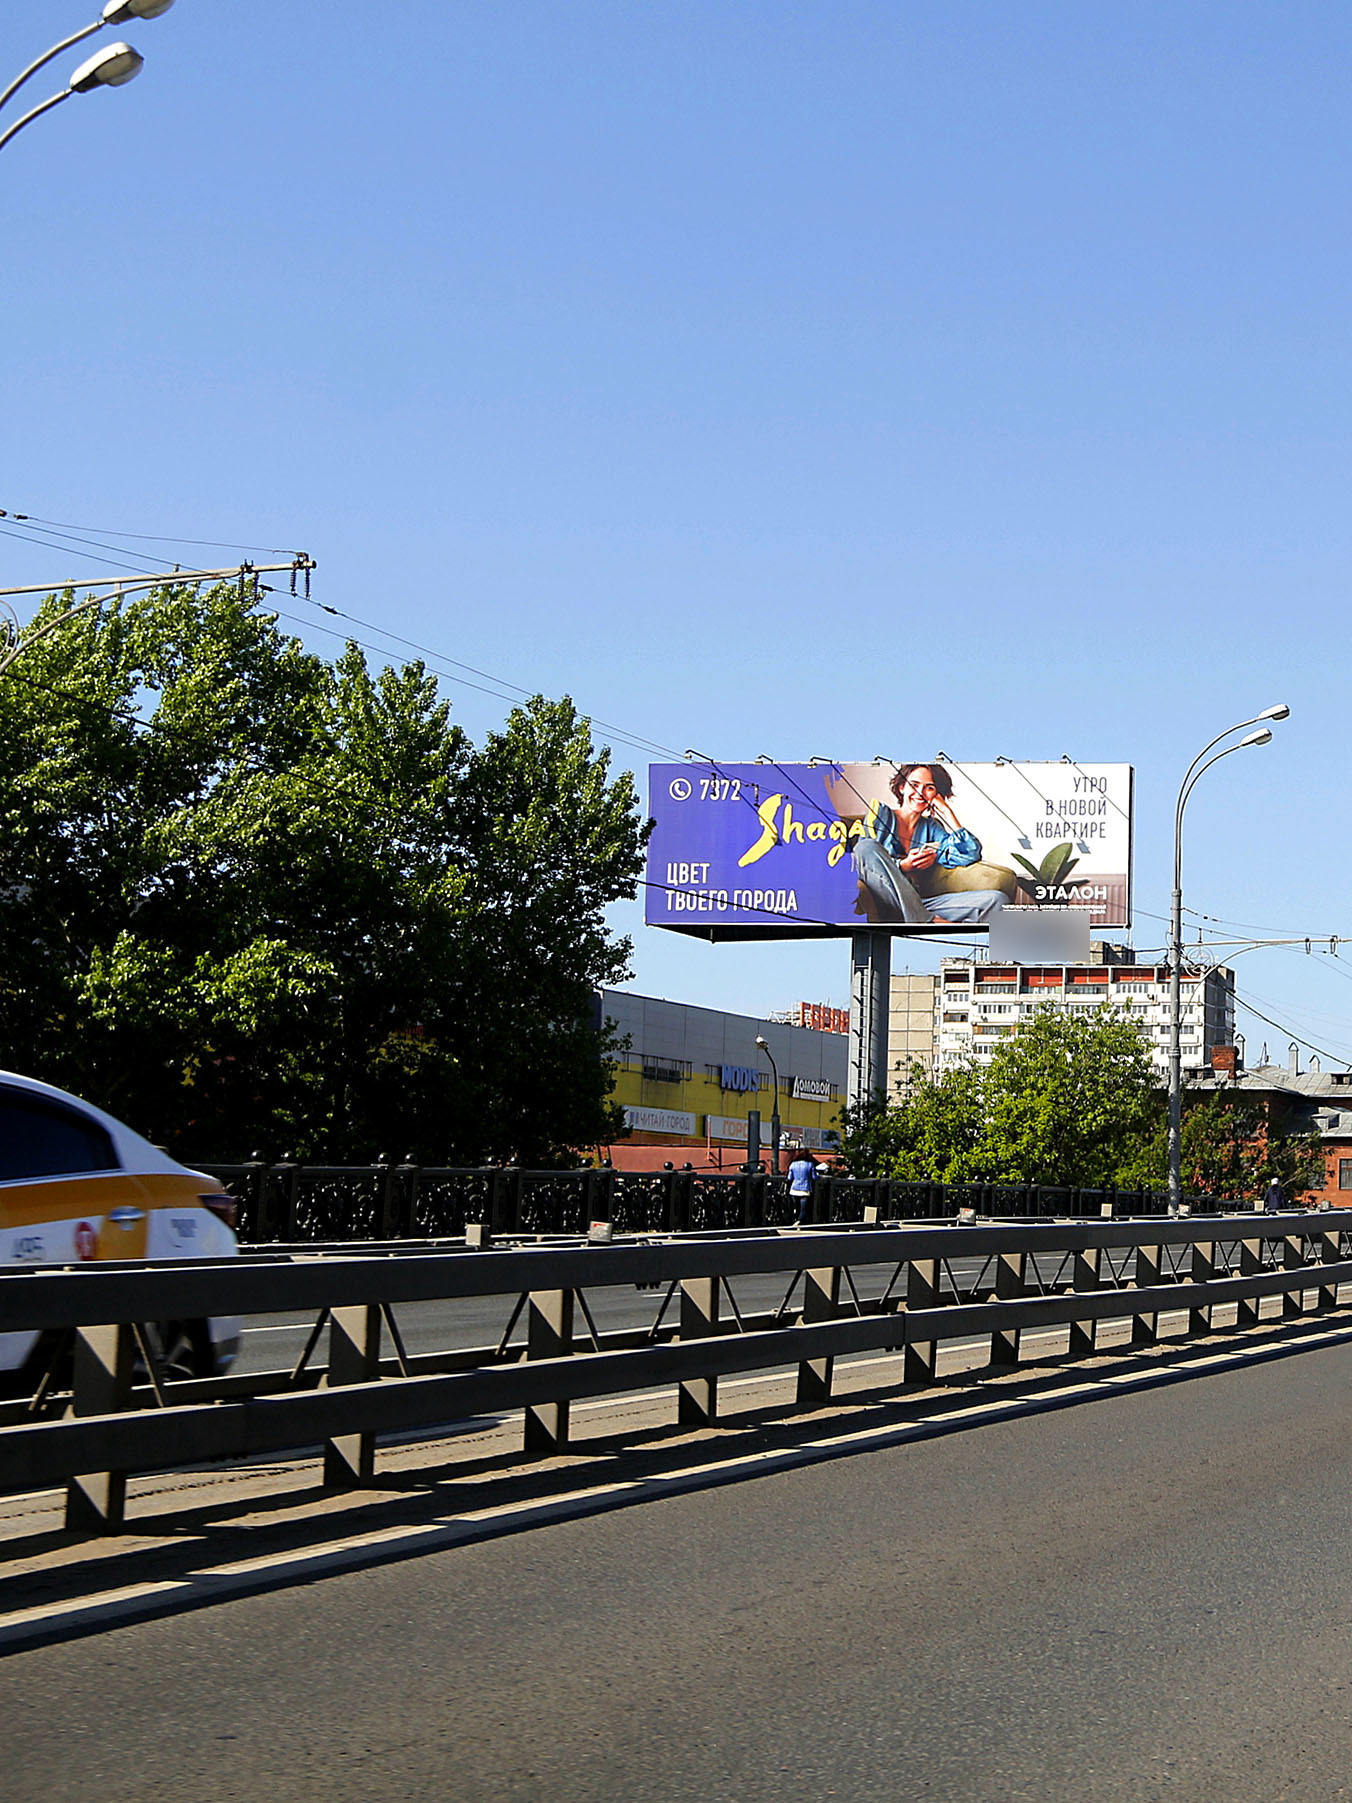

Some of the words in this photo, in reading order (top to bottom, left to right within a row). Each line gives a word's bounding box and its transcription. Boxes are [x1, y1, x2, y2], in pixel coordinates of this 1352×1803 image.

[700, 778, 741, 801] 7372
[1073, 776, 1107, 793] УТРО
[1045, 799, 1054, 816] В
[1059, 796, 1107, 816] НОВОЙ
[738, 793, 880, 868] Shagal
[1036, 821, 1107, 839] КВАРТИРЕ
[666, 862, 710, 887] ЦВЕТ
[665, 889, 728, 912] ТВОЕГО
[733, 889, 798, 914] ГОРОДА
[1035, 885, 1108, 900] ЭТАЛОН
